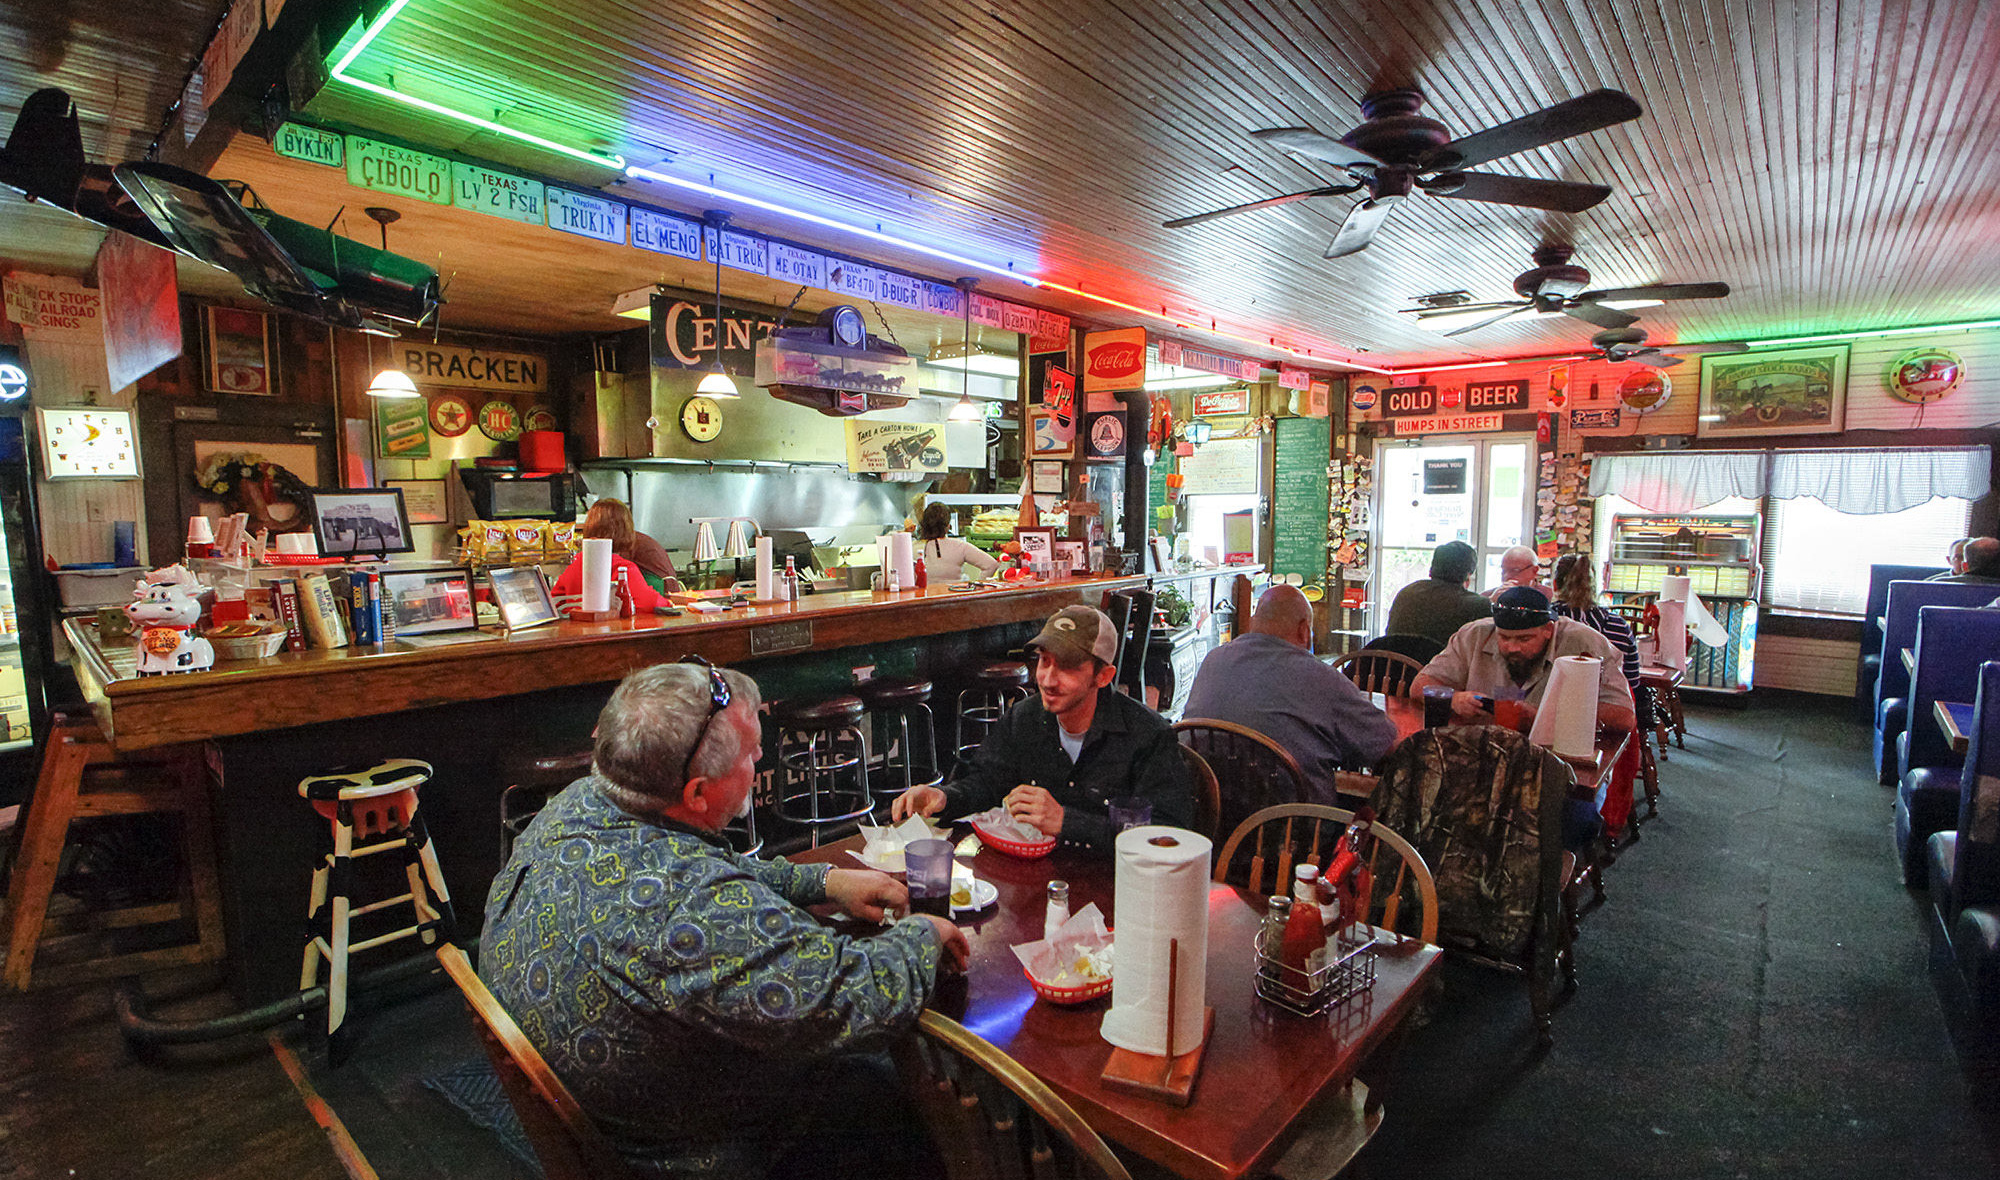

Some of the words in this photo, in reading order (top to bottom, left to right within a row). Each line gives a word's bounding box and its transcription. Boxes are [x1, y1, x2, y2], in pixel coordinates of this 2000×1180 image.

[284, 133, 334, 161] BYKIN
[379, 147, 422, 166] TEXAS
[362, 156, 441, 196] CIBOLO
[481, 173, 518, 190] TEXAS
[462, 180, 481, 200] LV
[490, 188, 500, 206] 2
[509, 192, 538, 214] FSH
[572, 196, 601, 211] Virginia
[561, 204, 615, 236] TRUKIN
[654, 217, 679, 230] Virginia
[635, 222, 654, 245] EL
[659, 229, 697, 254] MENO
[709, 239, 731, 260] RAT
[736, 245, 763, 268] TRUK
[787, 249, 807, 261] TEXAS
[793, 261, 817, 280] OTAY
[843, 264, 861, 274] TEXAS
[891, 274, 910, 286] TEXAS
[59, 292, 100, 307] STOPS
[927, 291, 960, 313] COWBOY
[405, 350, 538, 385] BRACKEN
[1094, 350, 1134, 371] Coca-Cola
[1389, 391, 1432, 411] COLD
[1470, 385, 1518, 406] BEER
[491, 412, 508, 429] HC
[1397, 419, 1434, 433] HUMPS
[1438, 419, 1449, 430] IN
[1453, 416, 1499, 429] STREET
[857, 430, 872, 441] TAKE
[880, 424, 901, 433] CARTON
[1428, 462, 1448, 470] THANK
[1450, 461, 1463, 469] YOU
